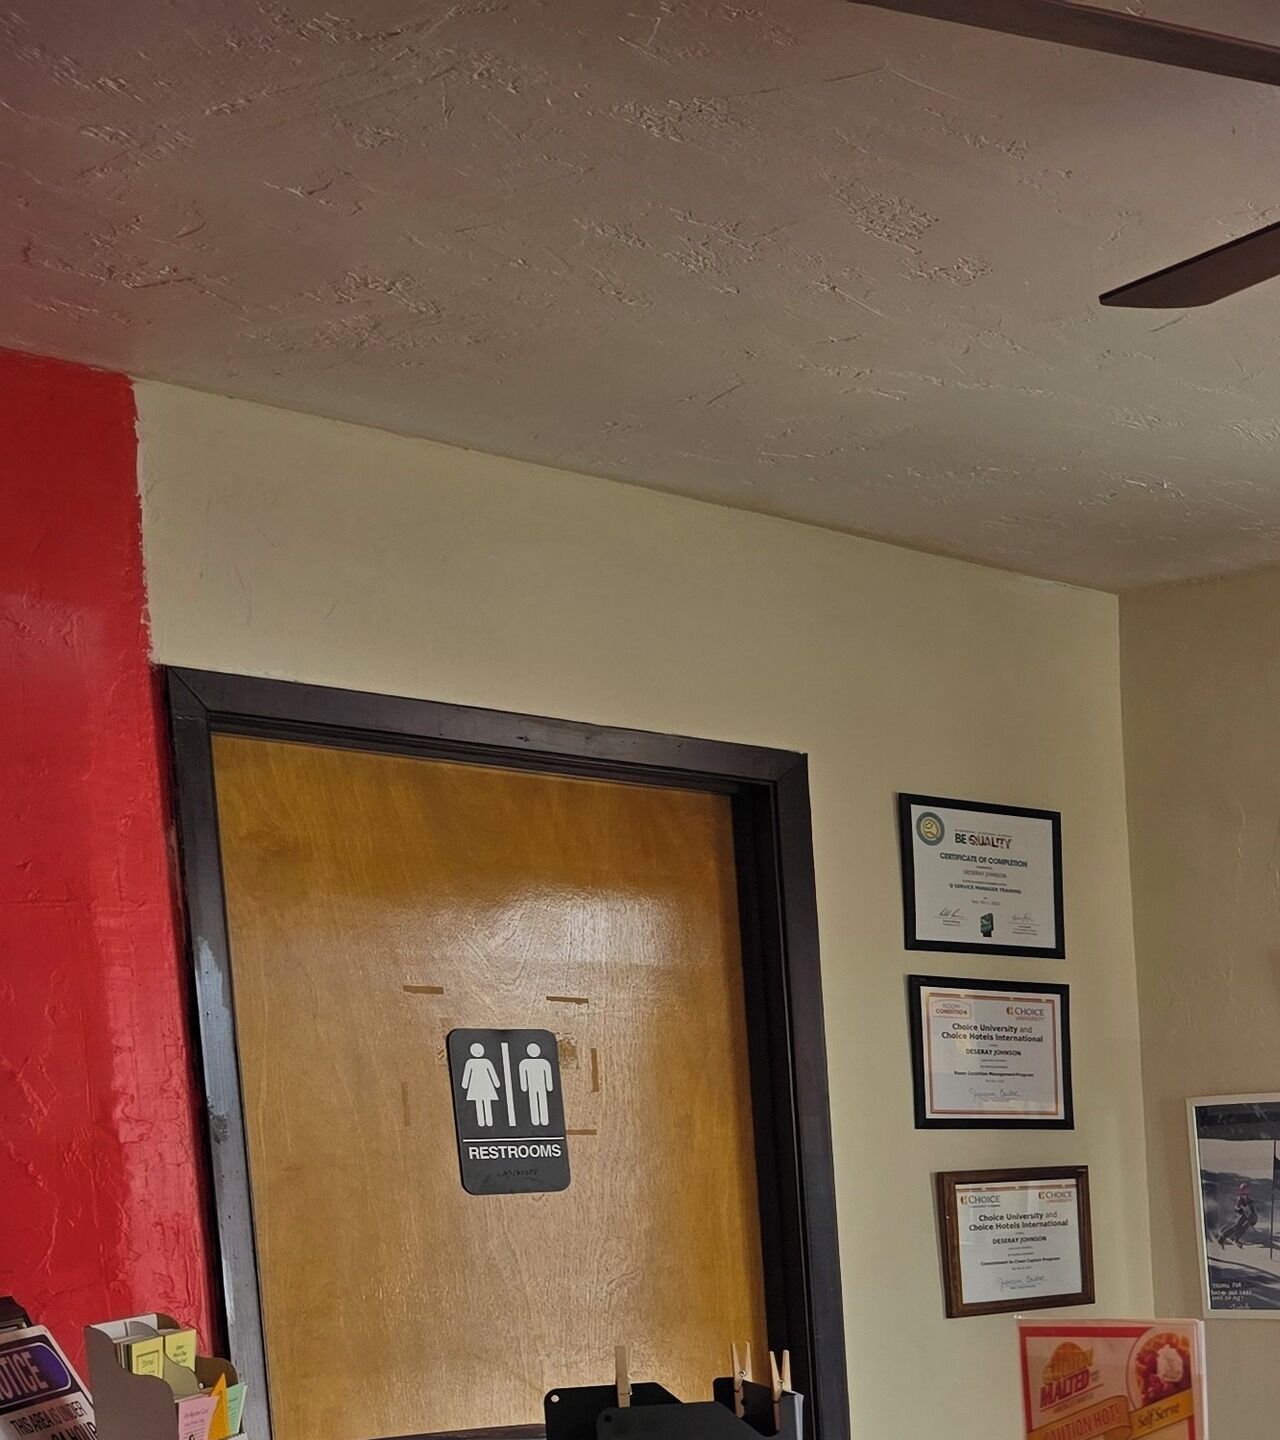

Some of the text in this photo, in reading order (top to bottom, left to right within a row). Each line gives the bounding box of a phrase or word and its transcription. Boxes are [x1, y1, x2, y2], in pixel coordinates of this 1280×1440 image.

[955, 833, 967, 844] BE
[969, 834, 1012, 849] QUALITY
[940, 852, 1028, 867] CERTIFICATE OF COMPLETION
[1015, 1007, 1045, 1017] CHOICE
[952, 1022, 978, 1031] Choice
[980, 1024, 1018, 1034] University
[941, 1031, 1044, 1042] Choice Hotels International
[468, 1144, 562, 1160] RESTROOMS
[968, 1195, 1001, 1204] CHOICE
[1045, 1191, 1072, 1199] CHOICE
[979, 1214, 1004, 1222] Choice
[1006, 1212, 1044, 1221] University
[969, 1219, 1069, 1232] Choice Hotels International
[1040, 1368, 1090, 1408] MALTED
[56, 1401, 88, 1422] UNDER
[1093, 1402, 1121, 1428] HOT!
[1154, 1403, 1180, 1421] Serve
